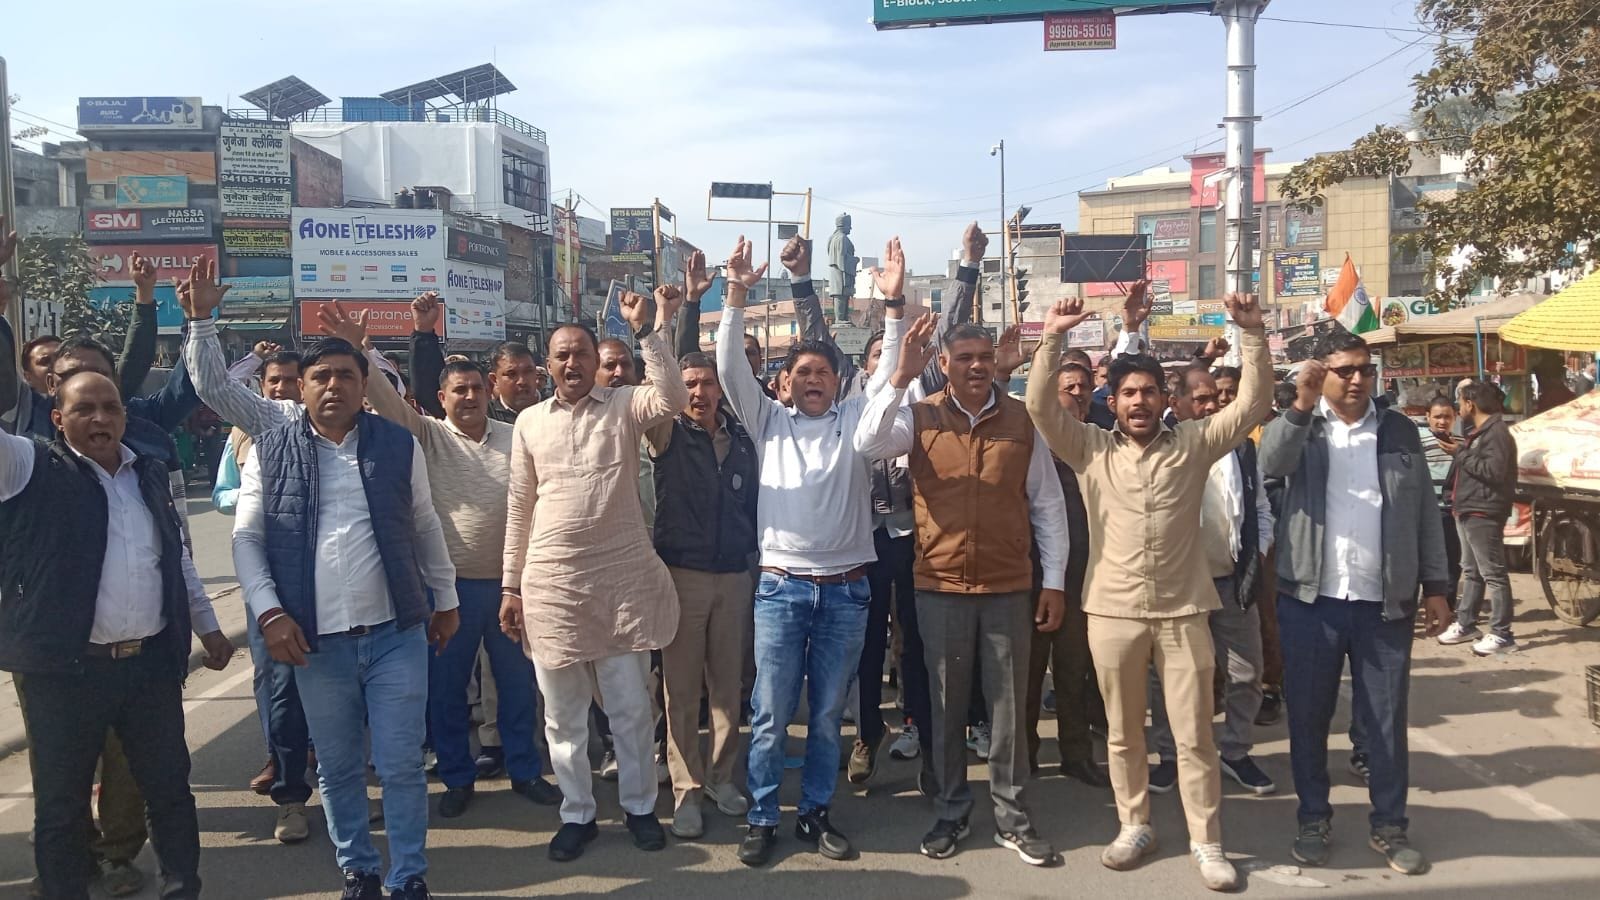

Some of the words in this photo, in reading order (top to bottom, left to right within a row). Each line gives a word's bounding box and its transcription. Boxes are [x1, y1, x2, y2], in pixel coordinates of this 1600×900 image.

[1049, 24, 1112, 38] 99966-55105
[222, 133, 248, 152] जुनेजा
[251, 134, 284, 149] क्लीनिक
[355, 223, 437, 240] TELESHOP
[127, 255, 201, 268] VELLS
